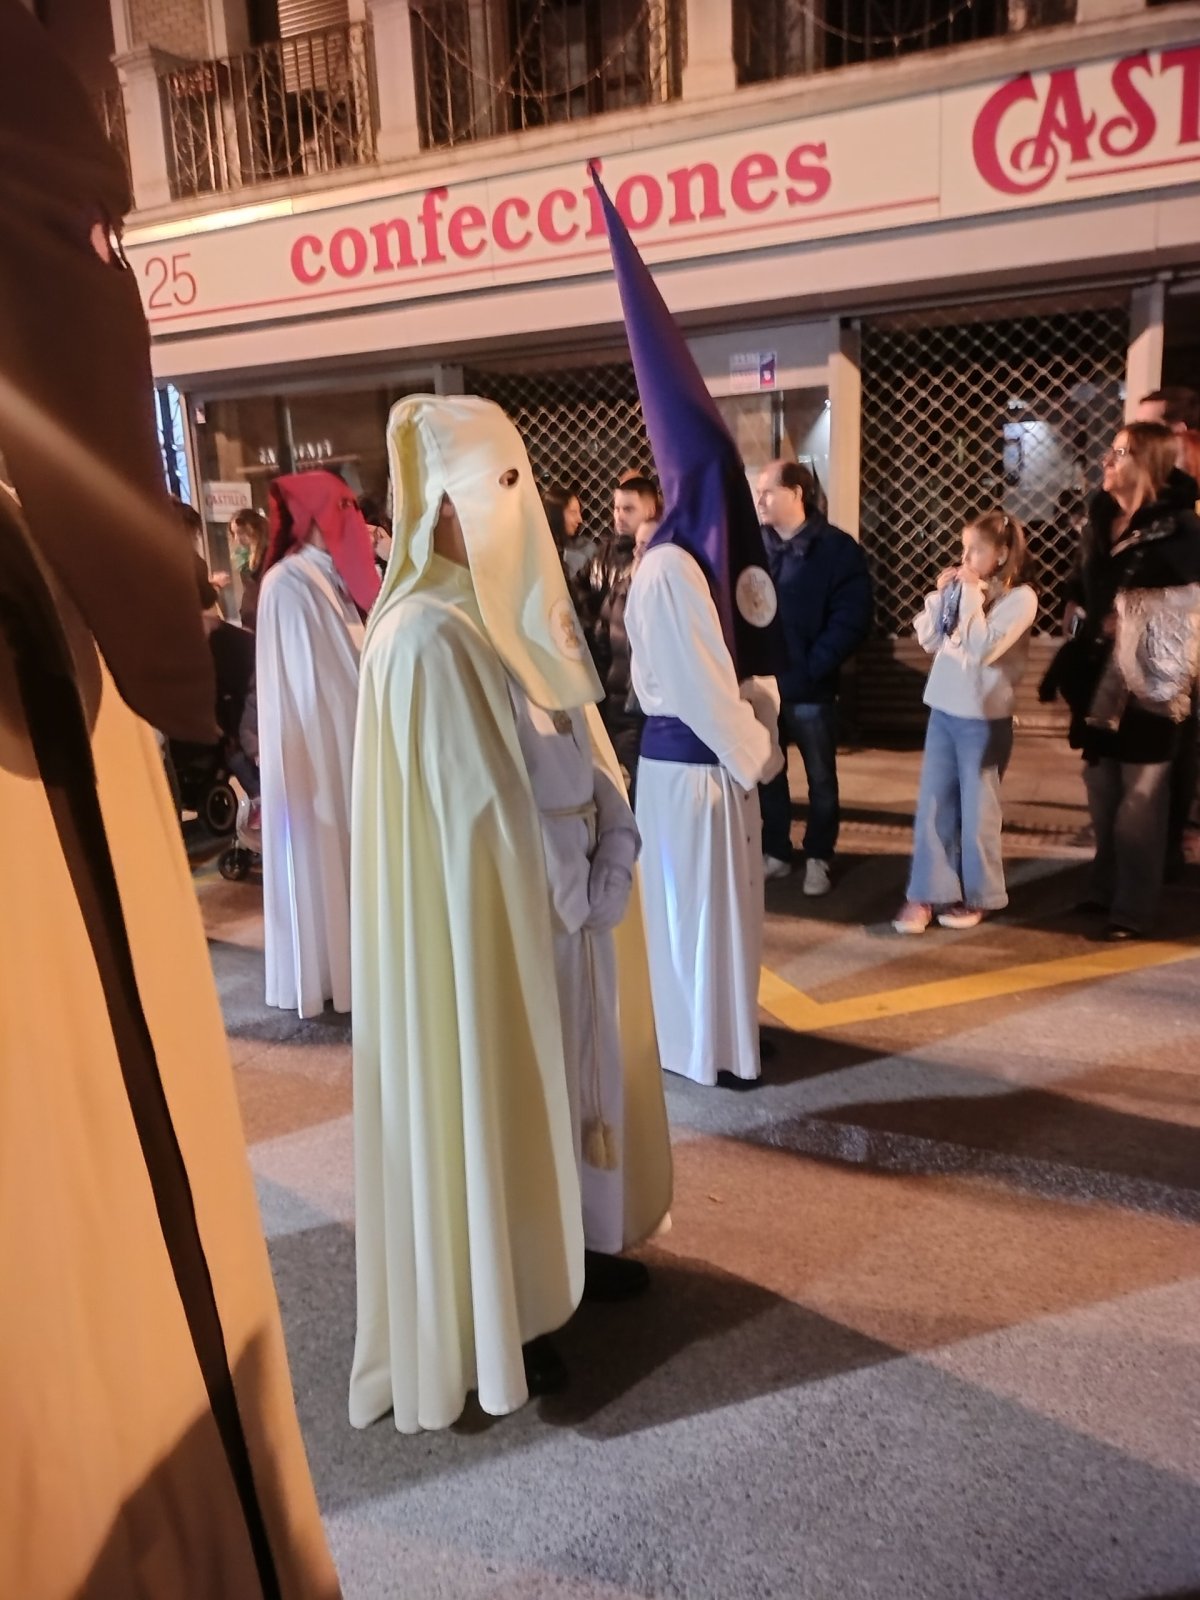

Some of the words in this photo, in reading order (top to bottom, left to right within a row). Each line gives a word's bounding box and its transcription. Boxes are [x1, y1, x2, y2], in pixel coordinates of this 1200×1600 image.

[290, 140, 832, 285] confecciones
[972, 47, 1200, 195] CAST
[144, 252, 197, 310] 25
